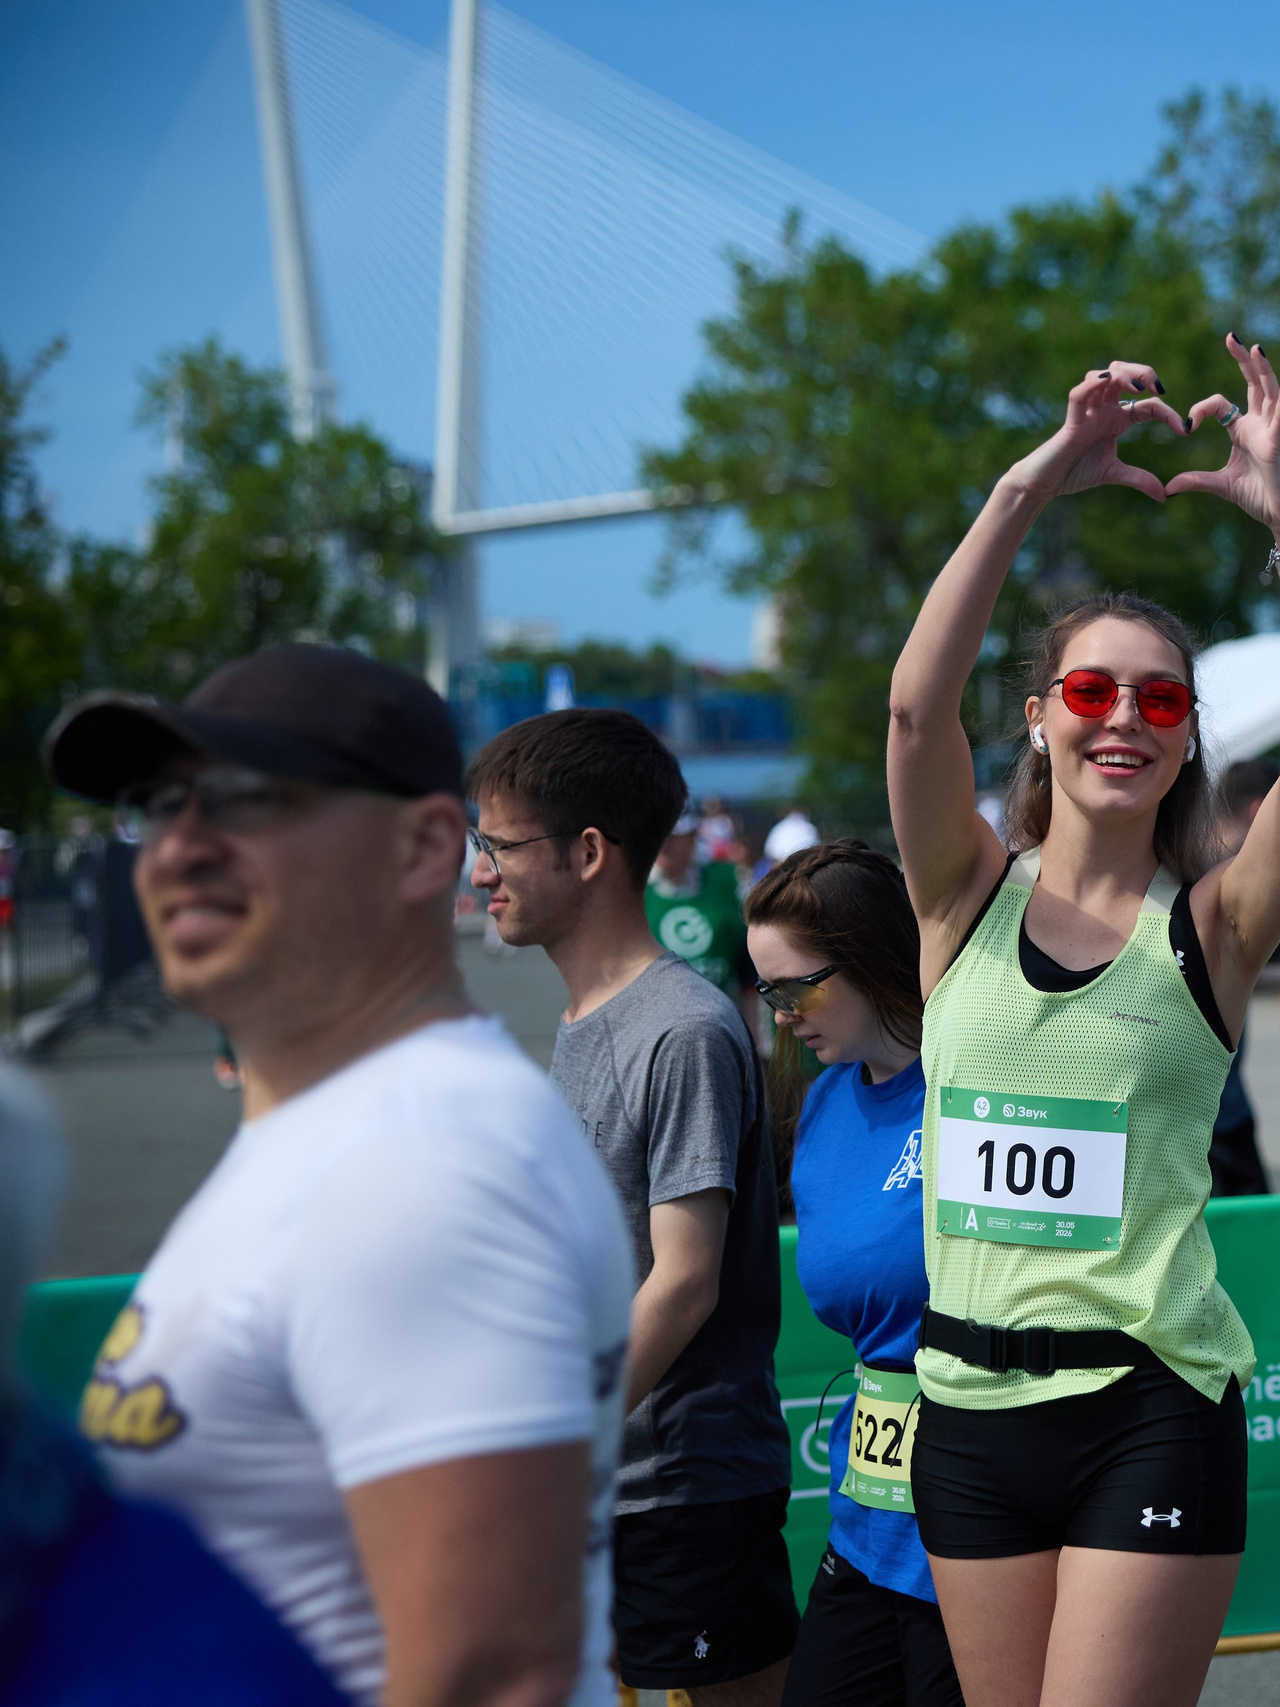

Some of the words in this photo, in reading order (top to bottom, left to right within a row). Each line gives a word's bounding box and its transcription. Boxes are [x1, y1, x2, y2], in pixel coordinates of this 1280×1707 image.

[1017, 1106, 1048, 1120] Звук
[977, 1139, 1076, 1199] 100
[964, 1207, 979, 1232] A
[1055, 1220, 1076, 1230] 30.05
[1055, 1229, 1073, 1238] 2026
[855, 1409, 903, 1468] 522
